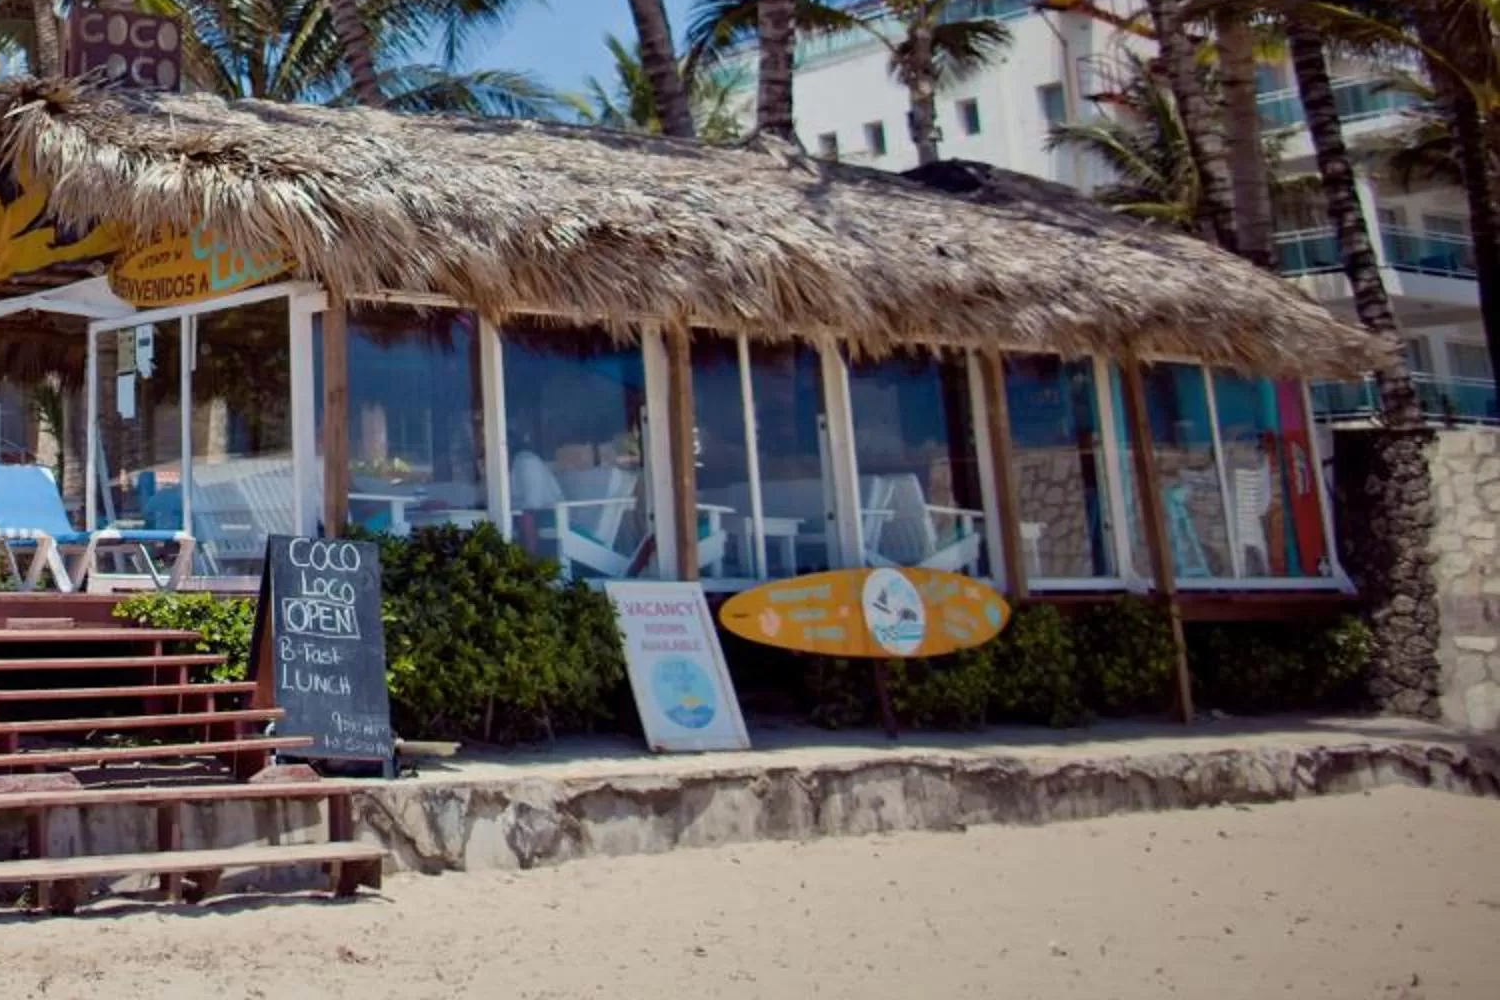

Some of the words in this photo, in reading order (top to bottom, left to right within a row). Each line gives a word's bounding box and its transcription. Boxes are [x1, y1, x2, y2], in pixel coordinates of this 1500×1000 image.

[80, 13, 178, 52] COCO
[199, 271, 209, 293] A
[289, 537, 361, 571] COCO
[301, 570, 356, 605] LOCO
[287, 600, 352, 633] OPEN
[624, 600, 693, 617] VACANCY
[281, 664, 352, 696] LUNCH
